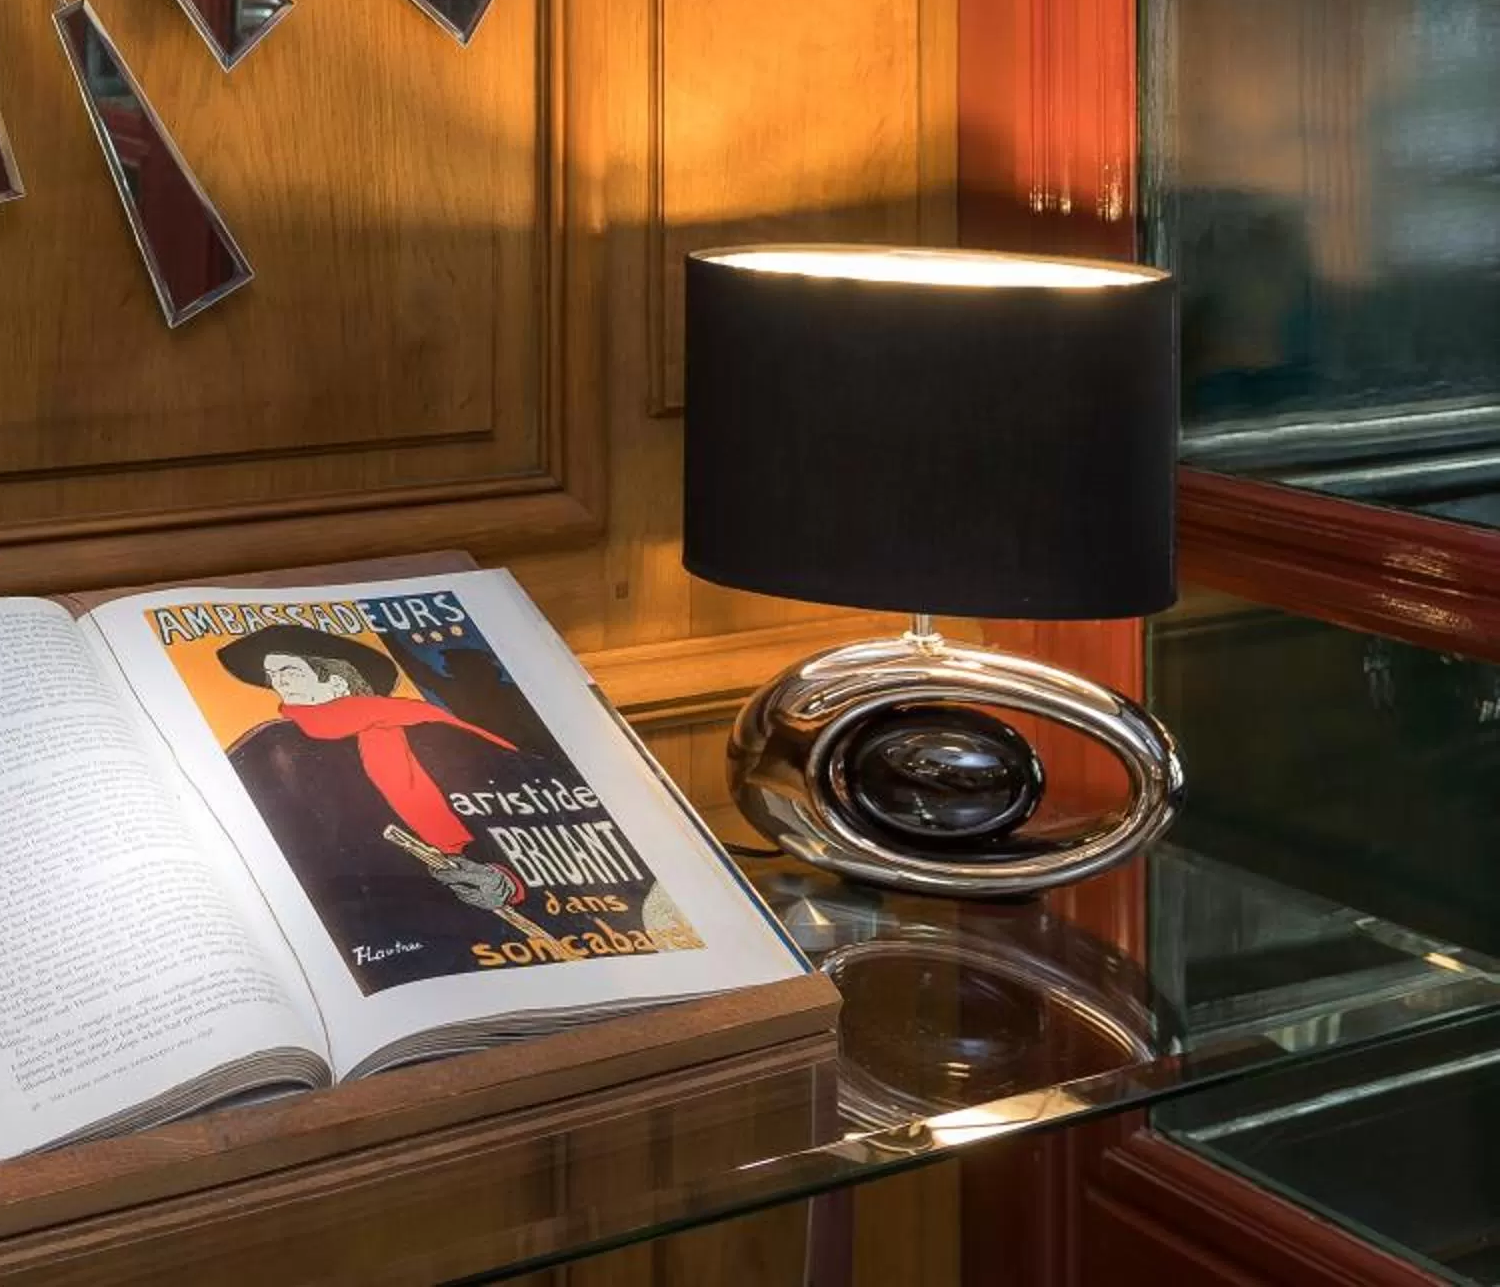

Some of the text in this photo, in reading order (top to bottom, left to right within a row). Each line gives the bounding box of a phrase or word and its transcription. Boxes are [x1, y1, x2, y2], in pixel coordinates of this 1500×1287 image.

[152, 594, 466, 646] AMBASSADEURS
[449, 778, 600, 816] aristide
[487, 820, 644, 888] BRUANT
[545, 890, 629, 915] dans
